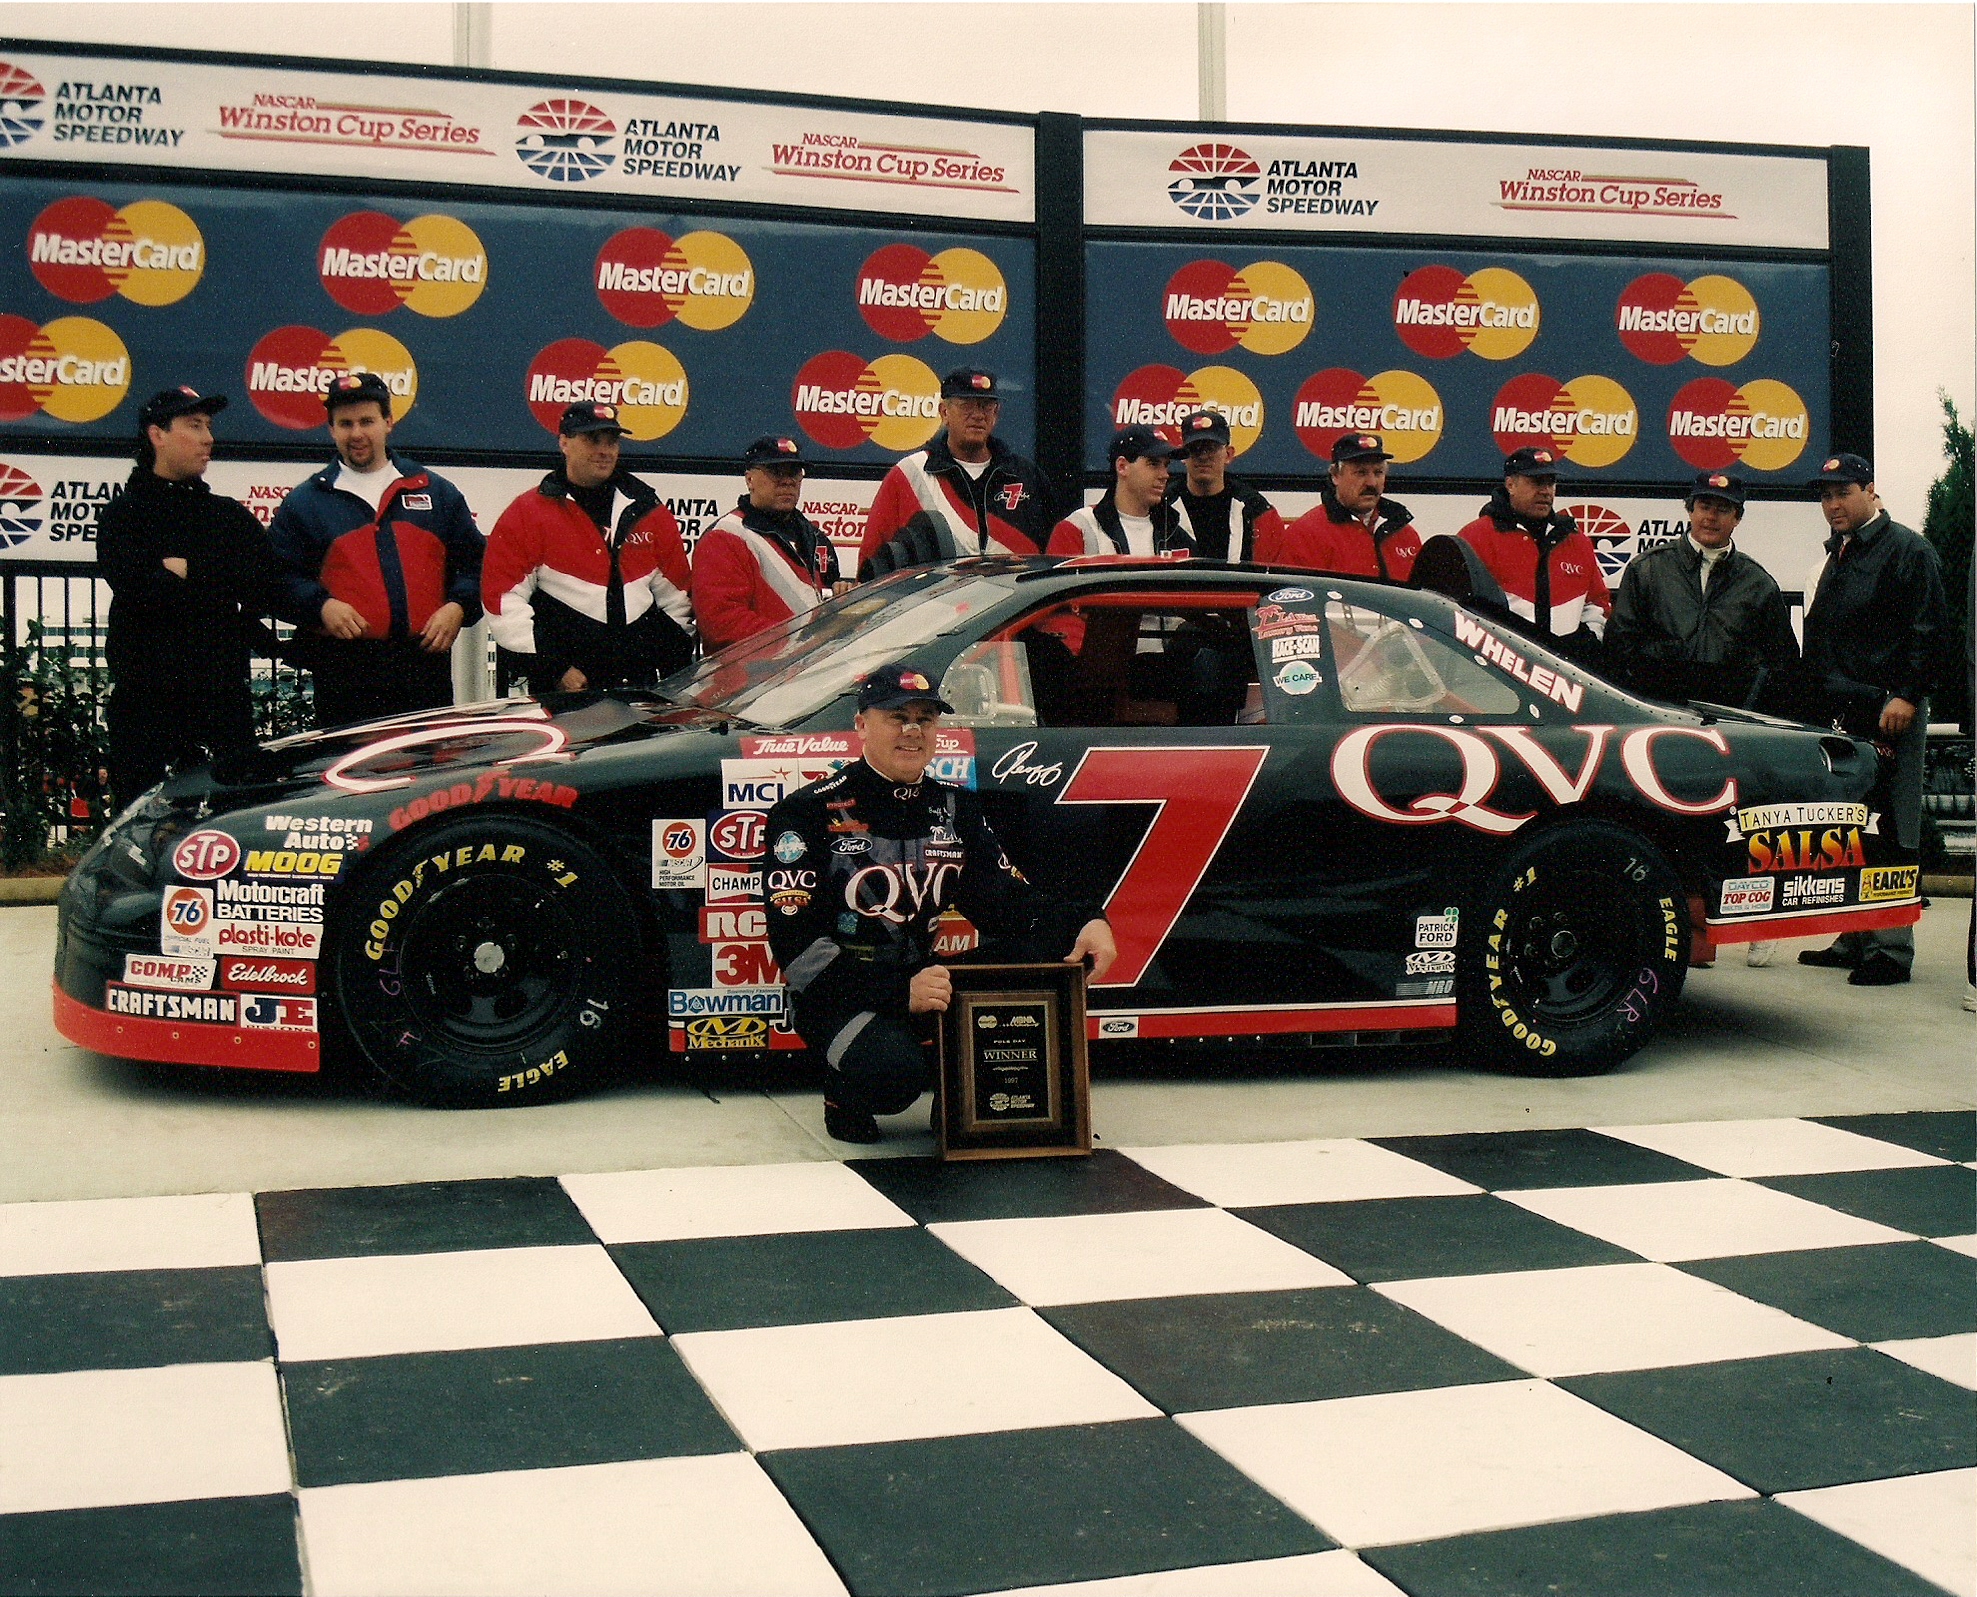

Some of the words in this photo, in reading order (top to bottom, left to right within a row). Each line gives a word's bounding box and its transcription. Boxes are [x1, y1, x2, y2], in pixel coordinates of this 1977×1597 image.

[55, 81, 162, 105] ATLANTA
[253, 93, 317, 110] NASCAR
[54, 102, 143, 124] MOTOR
[52, 123, 184, 149] SPEEDWAY
[218, 105, 332, 134] Winston
[335, 116, 395, 144] Cup
[399, 120, 480, 145] Series
[625, 119, 720, 142] ATLANTA
[624, 139, 703, 159] MOTOR
[802, 133, 858, 149] NASCAR
[622, 158, 742, 182] SPEEDWAY
[772, 145, 872, 171] Winston
[876, 154, 929, 179] Cup
[932, 158, 1005, 182] Series
[1266, 160, 1358, 179] ATLANTA
[1527, 168, 1582, 182] NASCAR
[1266, 179, 1342, 195] MOTOR
[1499, 181, 1596, 203] Winston
[1599, 185, 1651, 209] Cup
[1654, 188, 1723, 209] Series
[1266, 196, 1378, 216] SPEEDWAY
[31, 232, 201, 272] MasterCard
[322, 247, 483, 283] MasterCard
[597, 262, 750, 298] MasterCard
[859, 278, 1003, 312] MasterCard
[1166, 292, 1310, 323] MasterCard
[1396, 299, 1535, 329] MasterCard
[1618, 305, 1755, 335] MasterCard
[0, 355, 126, 386] sterCard
[530, 374, 685, 408] MasterCard
[795, 385, 942, 418] MasterCard
[1297, 402, 1438, 432] MasterCard
[1493, 407, 1633, 436] MasterCard
[1670, 411, 1805, 440] MasterCard
[50, 481, 126, 500] ATLAN
[249, 486, 293, 499] NASC
[1003, 483, 1023, 510] 7
[50, 502, 99, 521] MOT
[667, 498, 718, 517] ANTA
[802, 501, 858, 515] NASCAR
[1560, 561, 1583, 575] QVC
[1276, 591, 1307, 600] Ford
[1454, 611, 1584, 714] WHELEN
[1275, 676, 1291, 685] WE
[1292, 673, 1317, 683] CARE
[923, 757, 971, 780] SCH
[1330, 724, 1738, 836] QVC
[728, 783, 784, 802] MCI
[266, 816, 373, 833] Western
[1741, 810, 1792, 829] TANYA
[1797, 806, 1865, 823] TUCKER'S
[284, 832, 345, 850] Auto
[666, 829, 693, 850] 76
[838, 840, 867, 851] Ford
[1748, 826, 1866, 874] SALSA
[179, 836, 231, 871] STP
[244, 851, 343, 874] MOOG
[925, 849, 963, 859] CRAFTSMAN
[1055, 745, 1271, 989] 7
[712, 877, 760, 892] CHAMP
[767, 870, 817, 890] QVC
[1783, 875, 1846, 897] sikkens
[1872, 869, 1917, 891] EARL'S
[218, 879, 325, 905] Motorcraft
[365, 843, 526, 961] GOODYEAR
[547, 859, 579, 888] #1
[1723, 893, 1746, 905] TOP
[1748, 891, 1771, 903] COG
[1782, 897, 1798, 907] CAR
[1802, 895, 1844, 905] REFINISHES
[171, 899, 203, 926] 76
[217, 904, 323, 923] BATTERIES
[219, 923, 316, 948] plasti-kote
[1418, 924, 1455, 932] PATRICK
[1419, 933, 1453, 942] FORD
[1658, 897, 1679, 962] EAGLE
[242, 945, 269, 954] SPRAY
[272, 947, 295, 956] PAINT
[130, 960, 192, 979] COMP
[227, 964, 307, 986] Edelbrock
[715, 944, 789, 986] 3M
[1486, 908, 1557, 1057] GOODYEAR
[107, 988, 236, 1022] CRAFTSMAN
[245, 997, 313, 1026] JE
[670, 992, 781, 1013] Bowman
[1107, 1021, 1131, 1032] Ford
[984, 1051, 1037, 1060] WINNER
[498, 1049, 569, 1092] EAGLE
